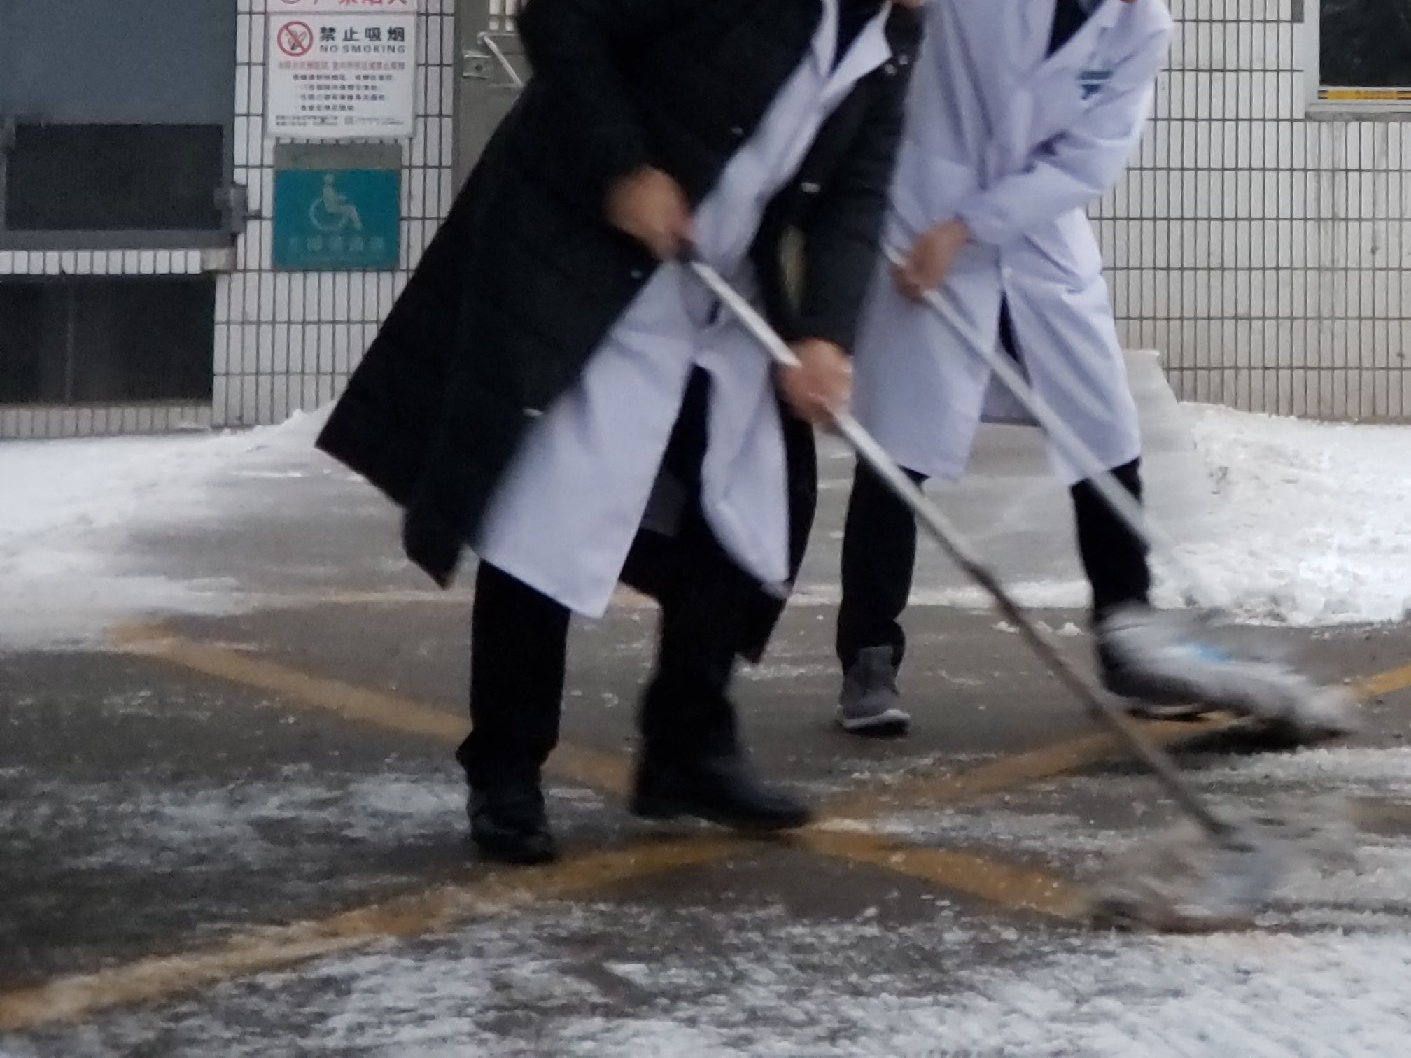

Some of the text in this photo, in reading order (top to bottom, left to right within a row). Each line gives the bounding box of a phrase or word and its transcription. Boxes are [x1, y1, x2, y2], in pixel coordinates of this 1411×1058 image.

[320, 27, 405, 42] 禁止吸烟
[320, 45, 405, 53] NO SMOKING
